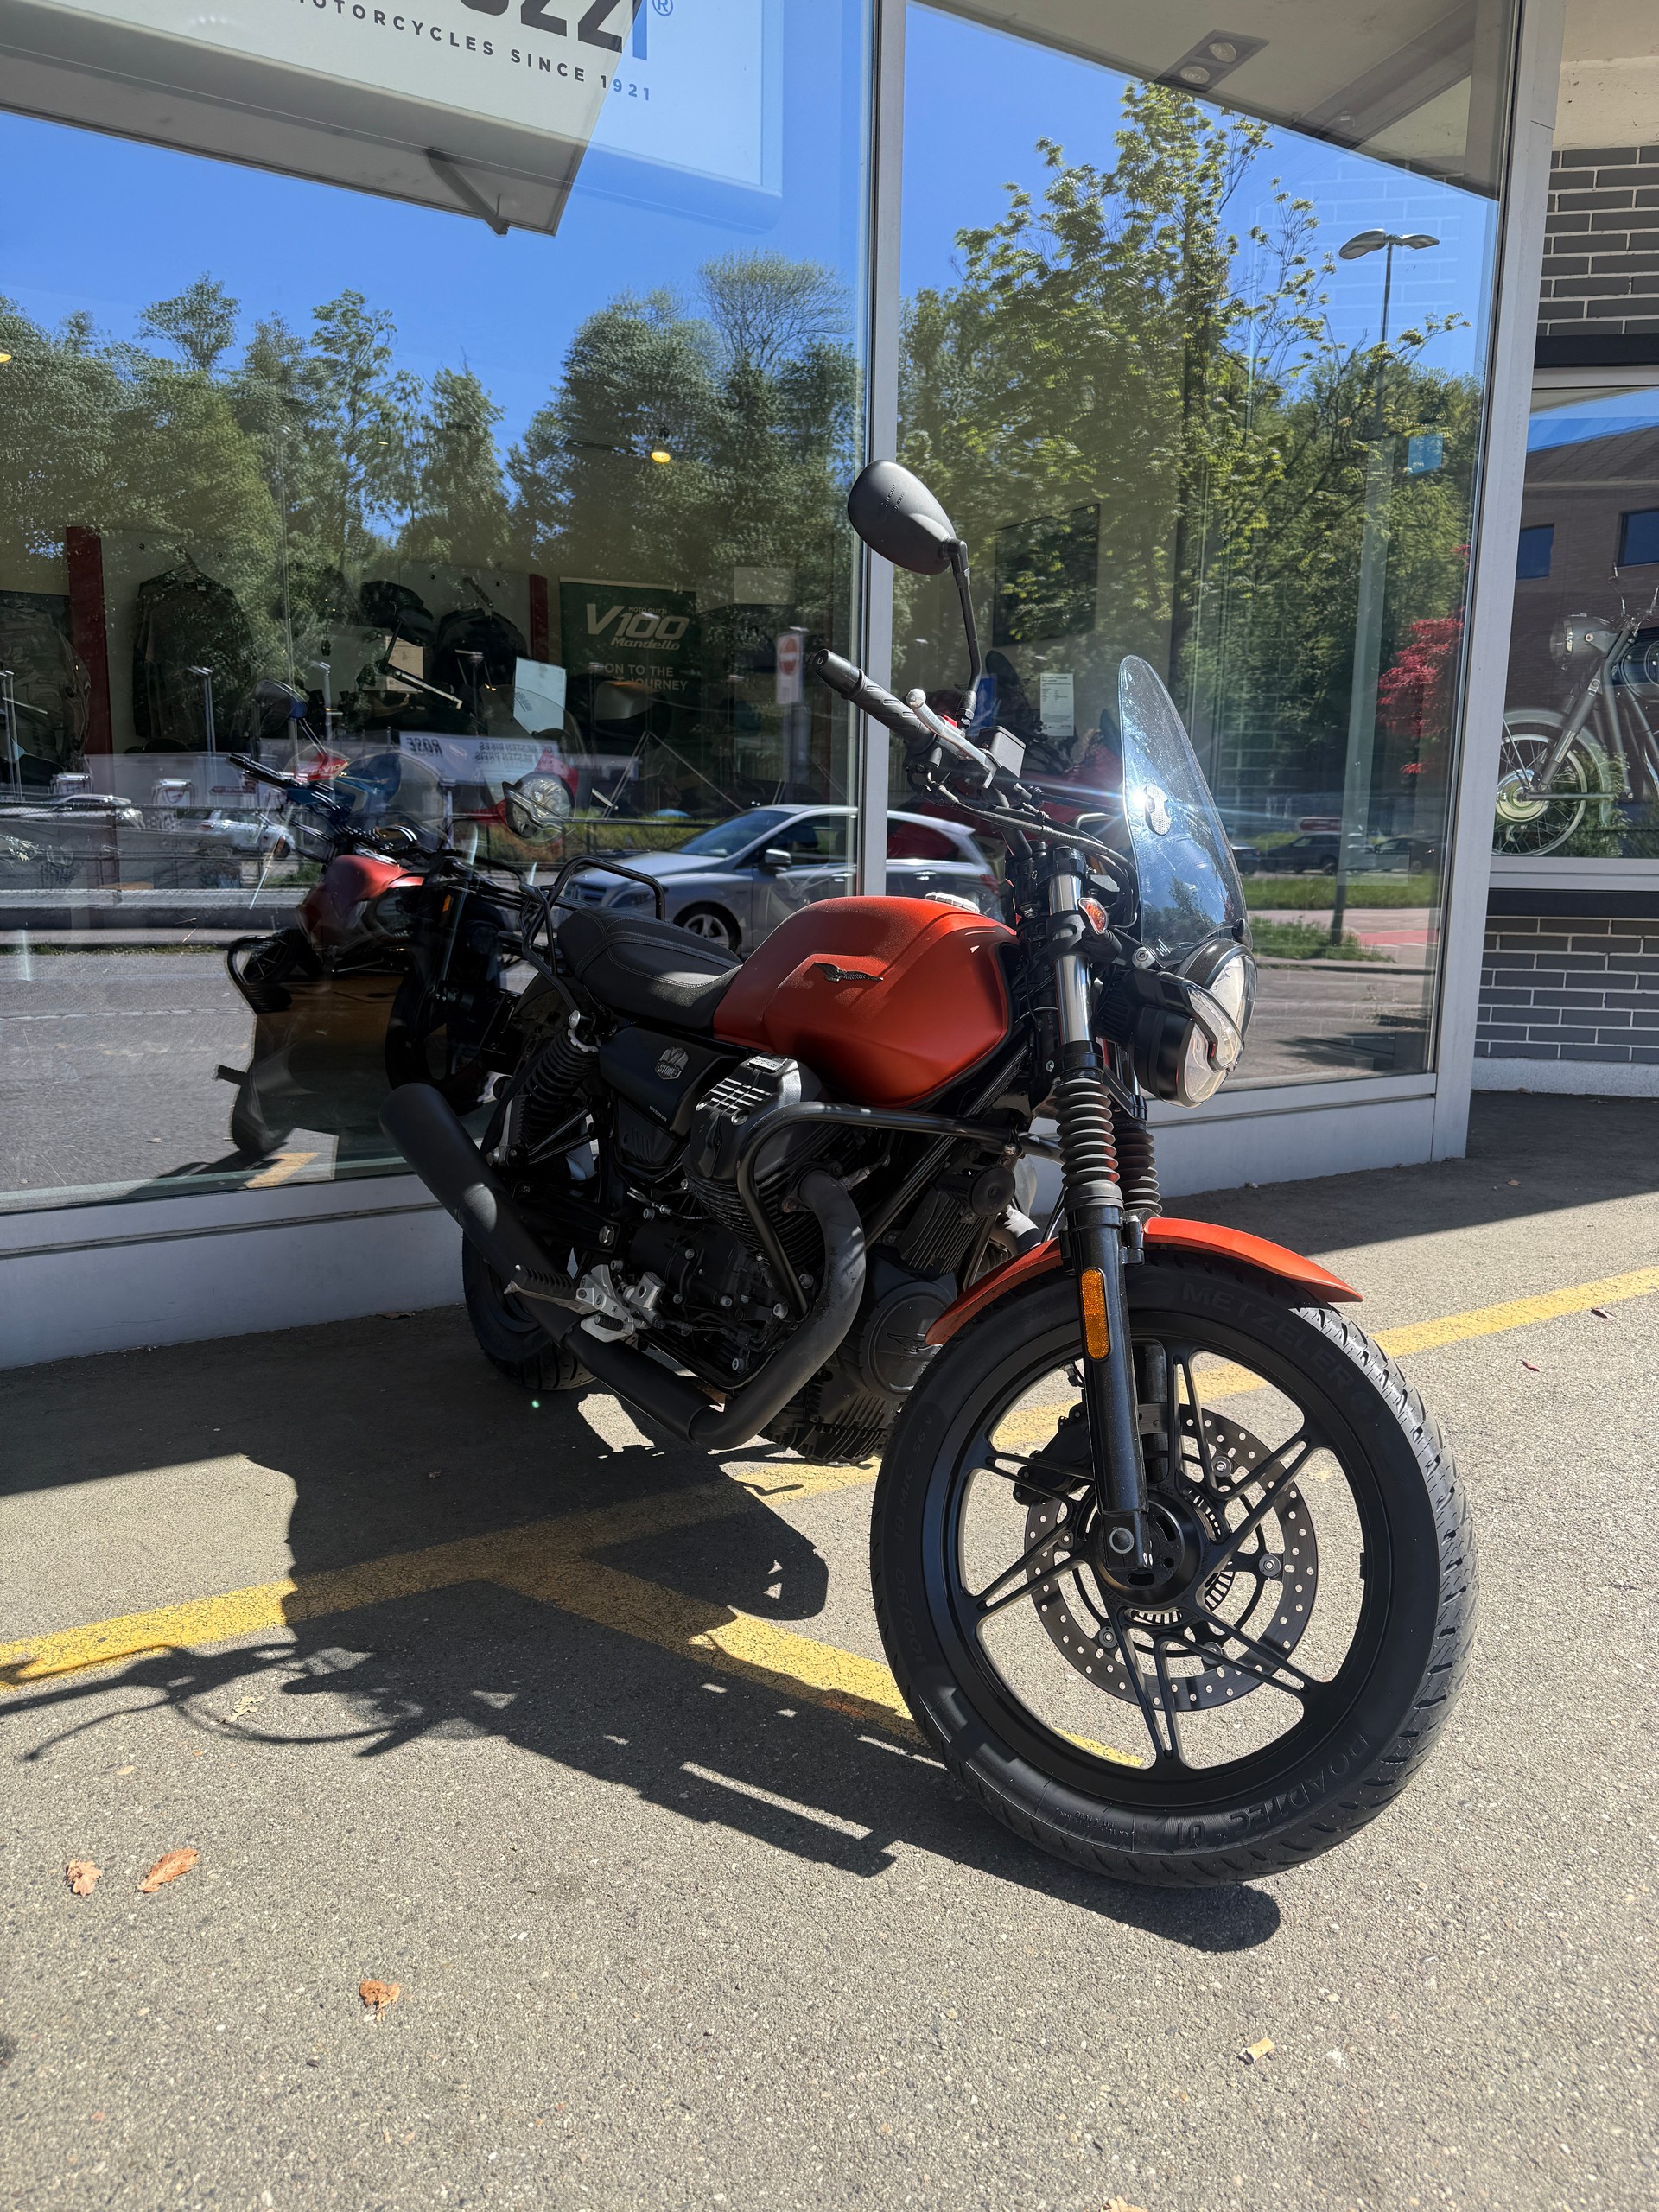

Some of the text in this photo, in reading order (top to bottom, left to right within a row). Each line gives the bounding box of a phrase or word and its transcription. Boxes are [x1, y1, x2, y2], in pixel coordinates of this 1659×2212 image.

[511, 49, 585, 82] SINCE
[601, 75, 650, 101] 1921
[586, 603, 690, 640] V100
[610, 637, 681, 651] Mandello
[604, 663, 674, 677] ON TO THE
[1182, 1282, 1356, 1392] METZELER
[1230, 1731, 1370, 1835] ROADTEC
